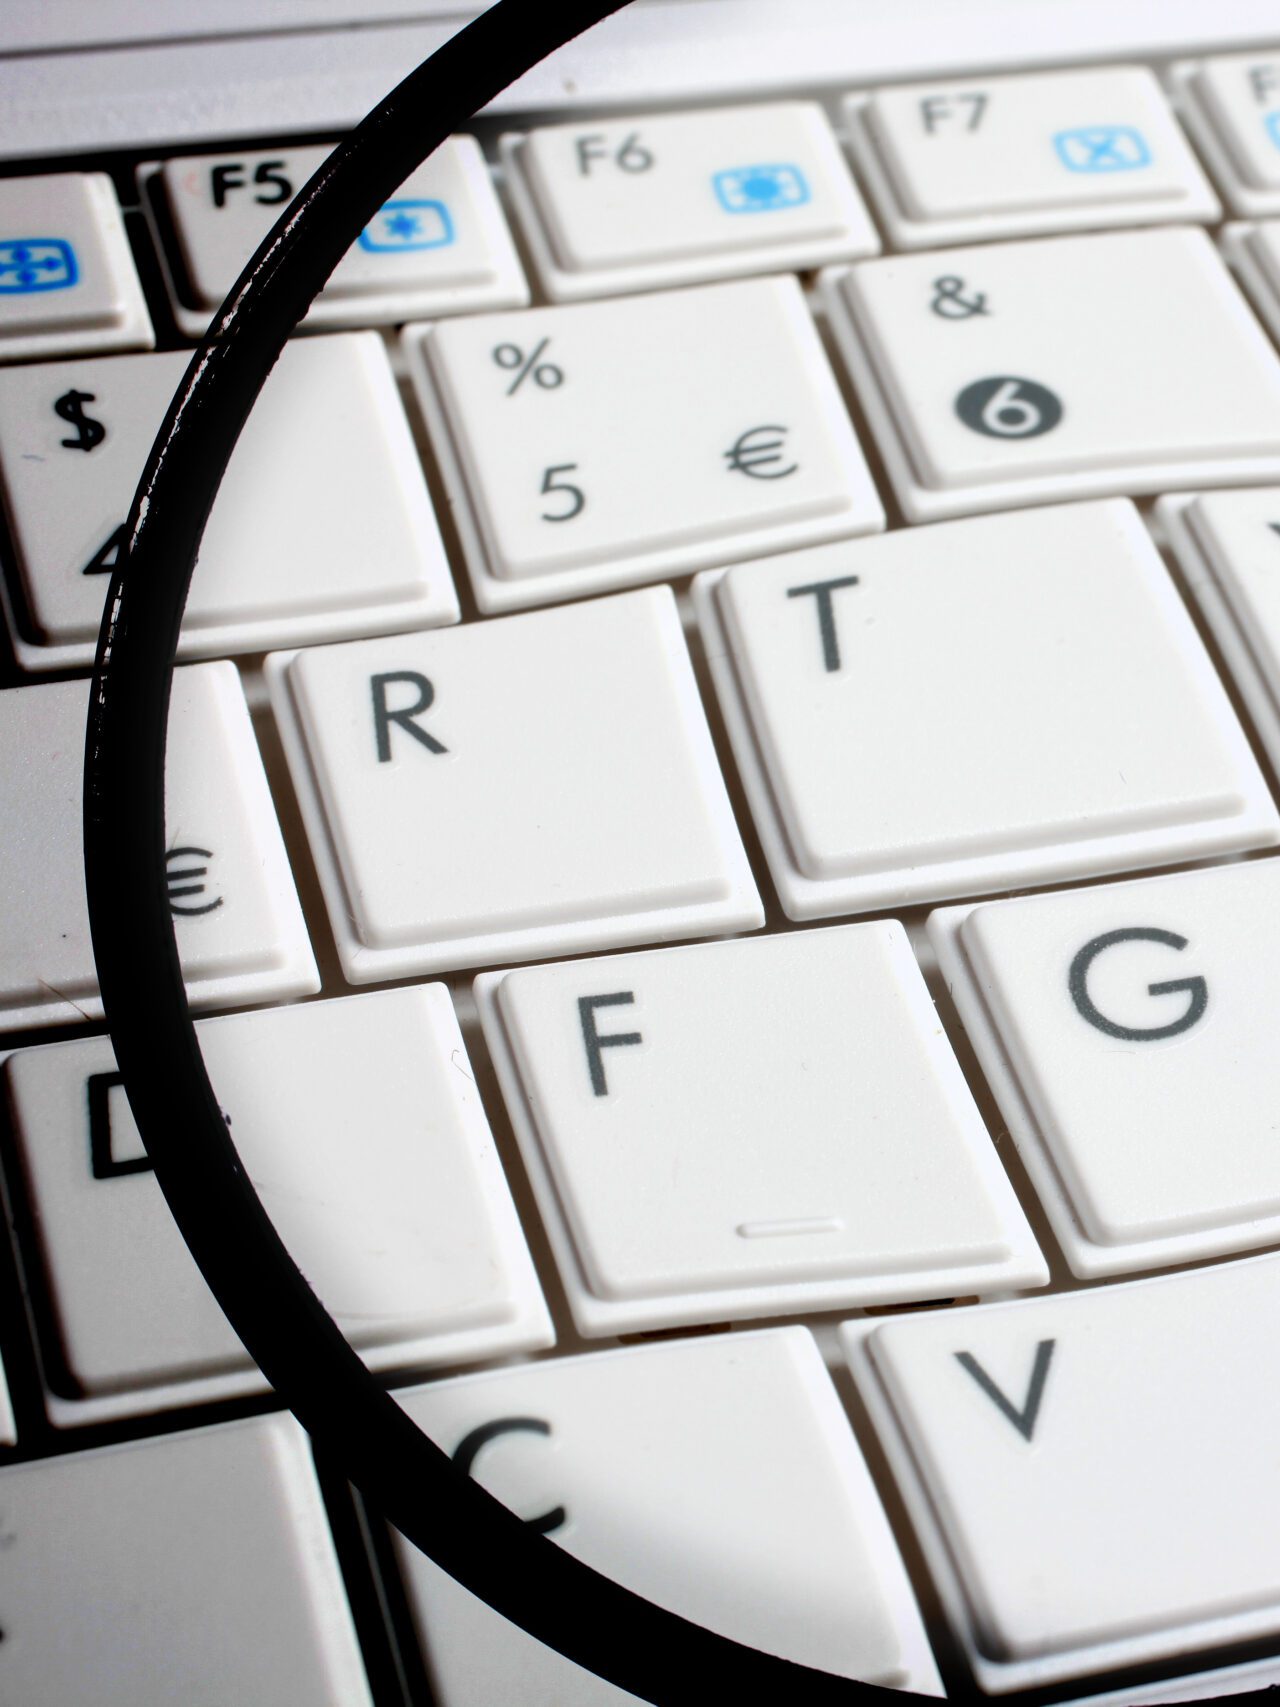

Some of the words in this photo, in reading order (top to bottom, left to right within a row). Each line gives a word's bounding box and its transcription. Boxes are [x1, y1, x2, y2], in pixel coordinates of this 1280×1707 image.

[919, 94, 990, 136] F7
[210, 161, 293, 209] F5
[574, 135, 655, 178] F6
[929, 275, 991, 321] &
[491, 337, 566, 397] %
[53, 388, 107, 454] $
[978, 378, 1046, 439] 6
[539, 463, 586, 524] 5
[723, 425, 799, 481] €
[786, 574, 860, 674] T
[369, 670, 450, 764] R
[1067, 926, 1210, 1043] G
[576, 990, 643, 1098] F
[953, 1338, 1057, 1443] V
